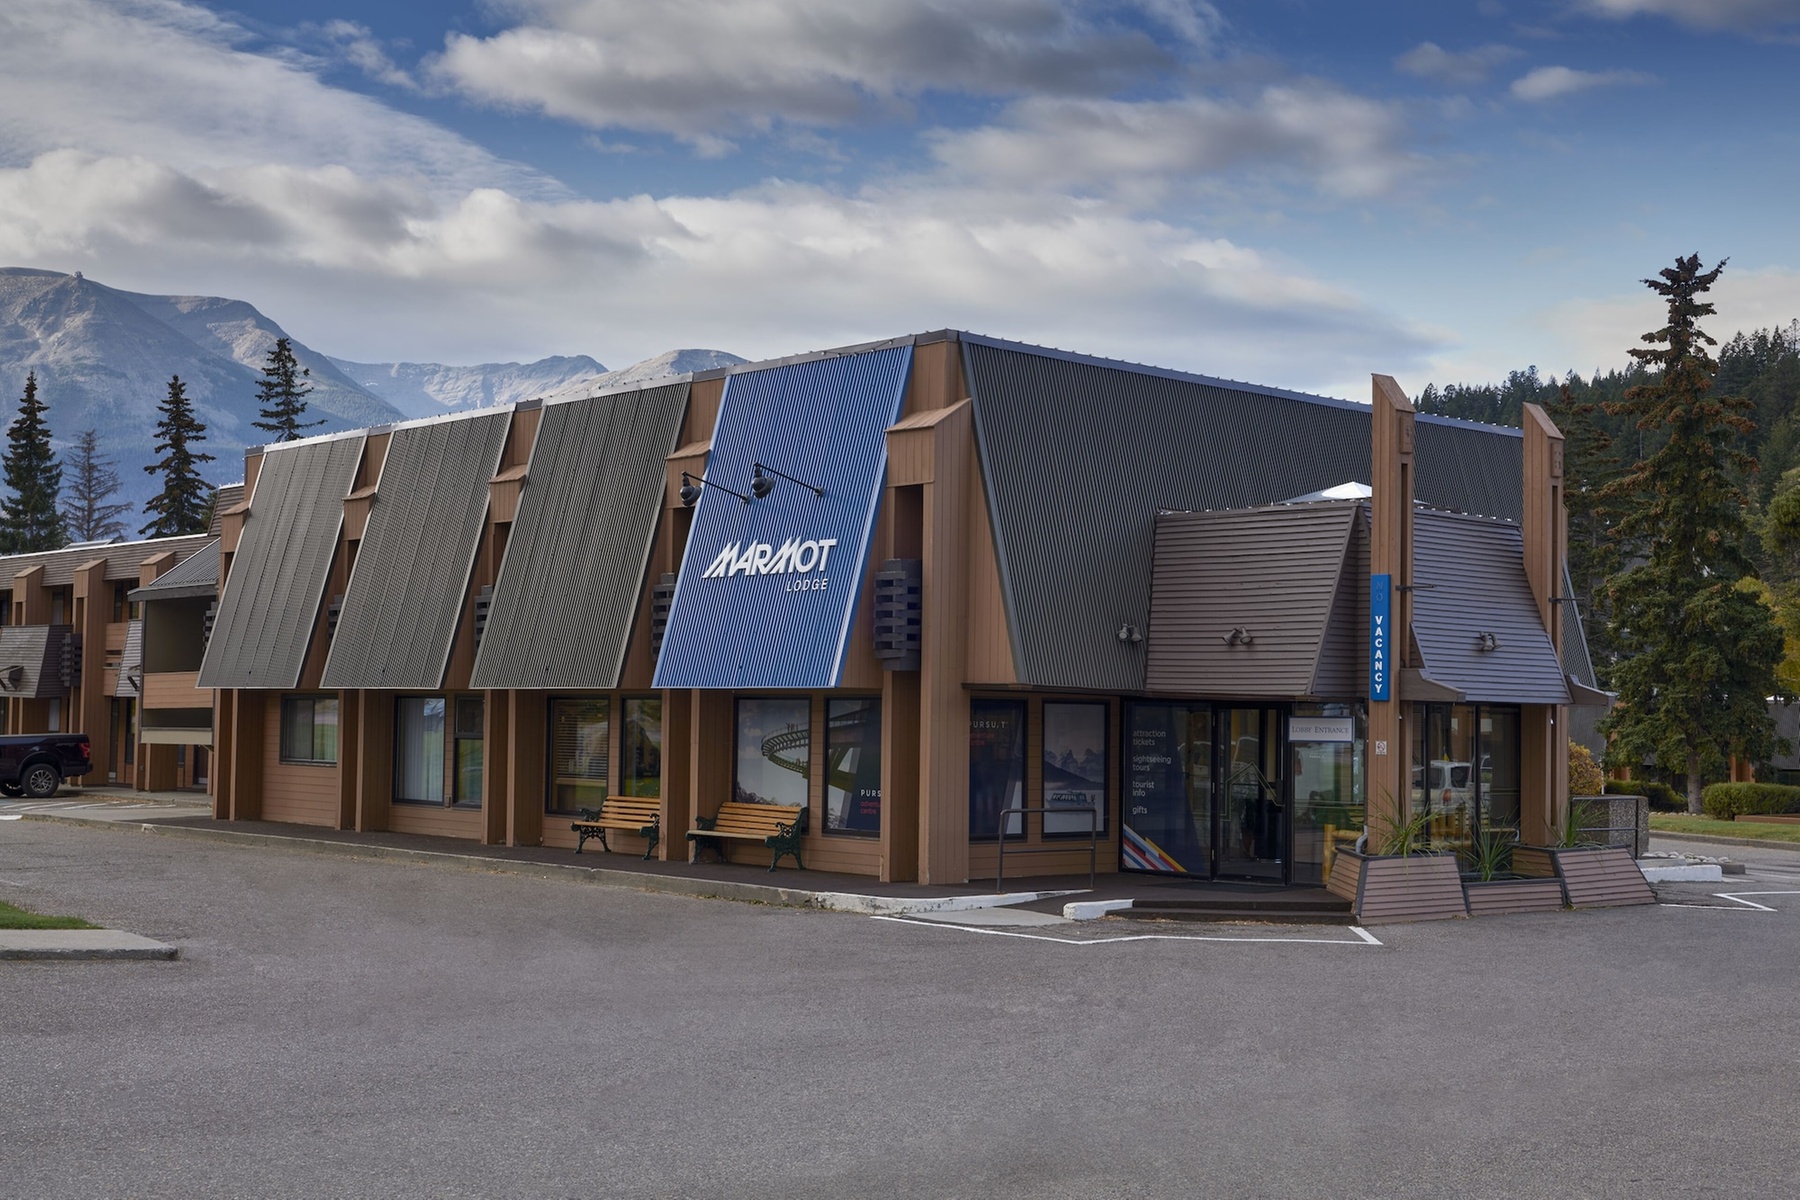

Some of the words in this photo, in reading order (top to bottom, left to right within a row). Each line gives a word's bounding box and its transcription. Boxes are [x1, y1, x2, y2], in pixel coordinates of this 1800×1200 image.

[702, 536, 837, 578] MARMOT
[787, 578, 828, 591] LODGE
[1374, 615, 1383, 693] VACANCY
[1132, 729, 1166, 738] attraction
[1132, 738, 1155, 746] tickets
[1132, 755, 1171, 765] sightseeing
[1132, 764, 1150, 772] tours
[1132, 781, 1155, 789] tourist
[1132, 789, 1146, 797] info
[1132, 805, 1148, 814] gifts
